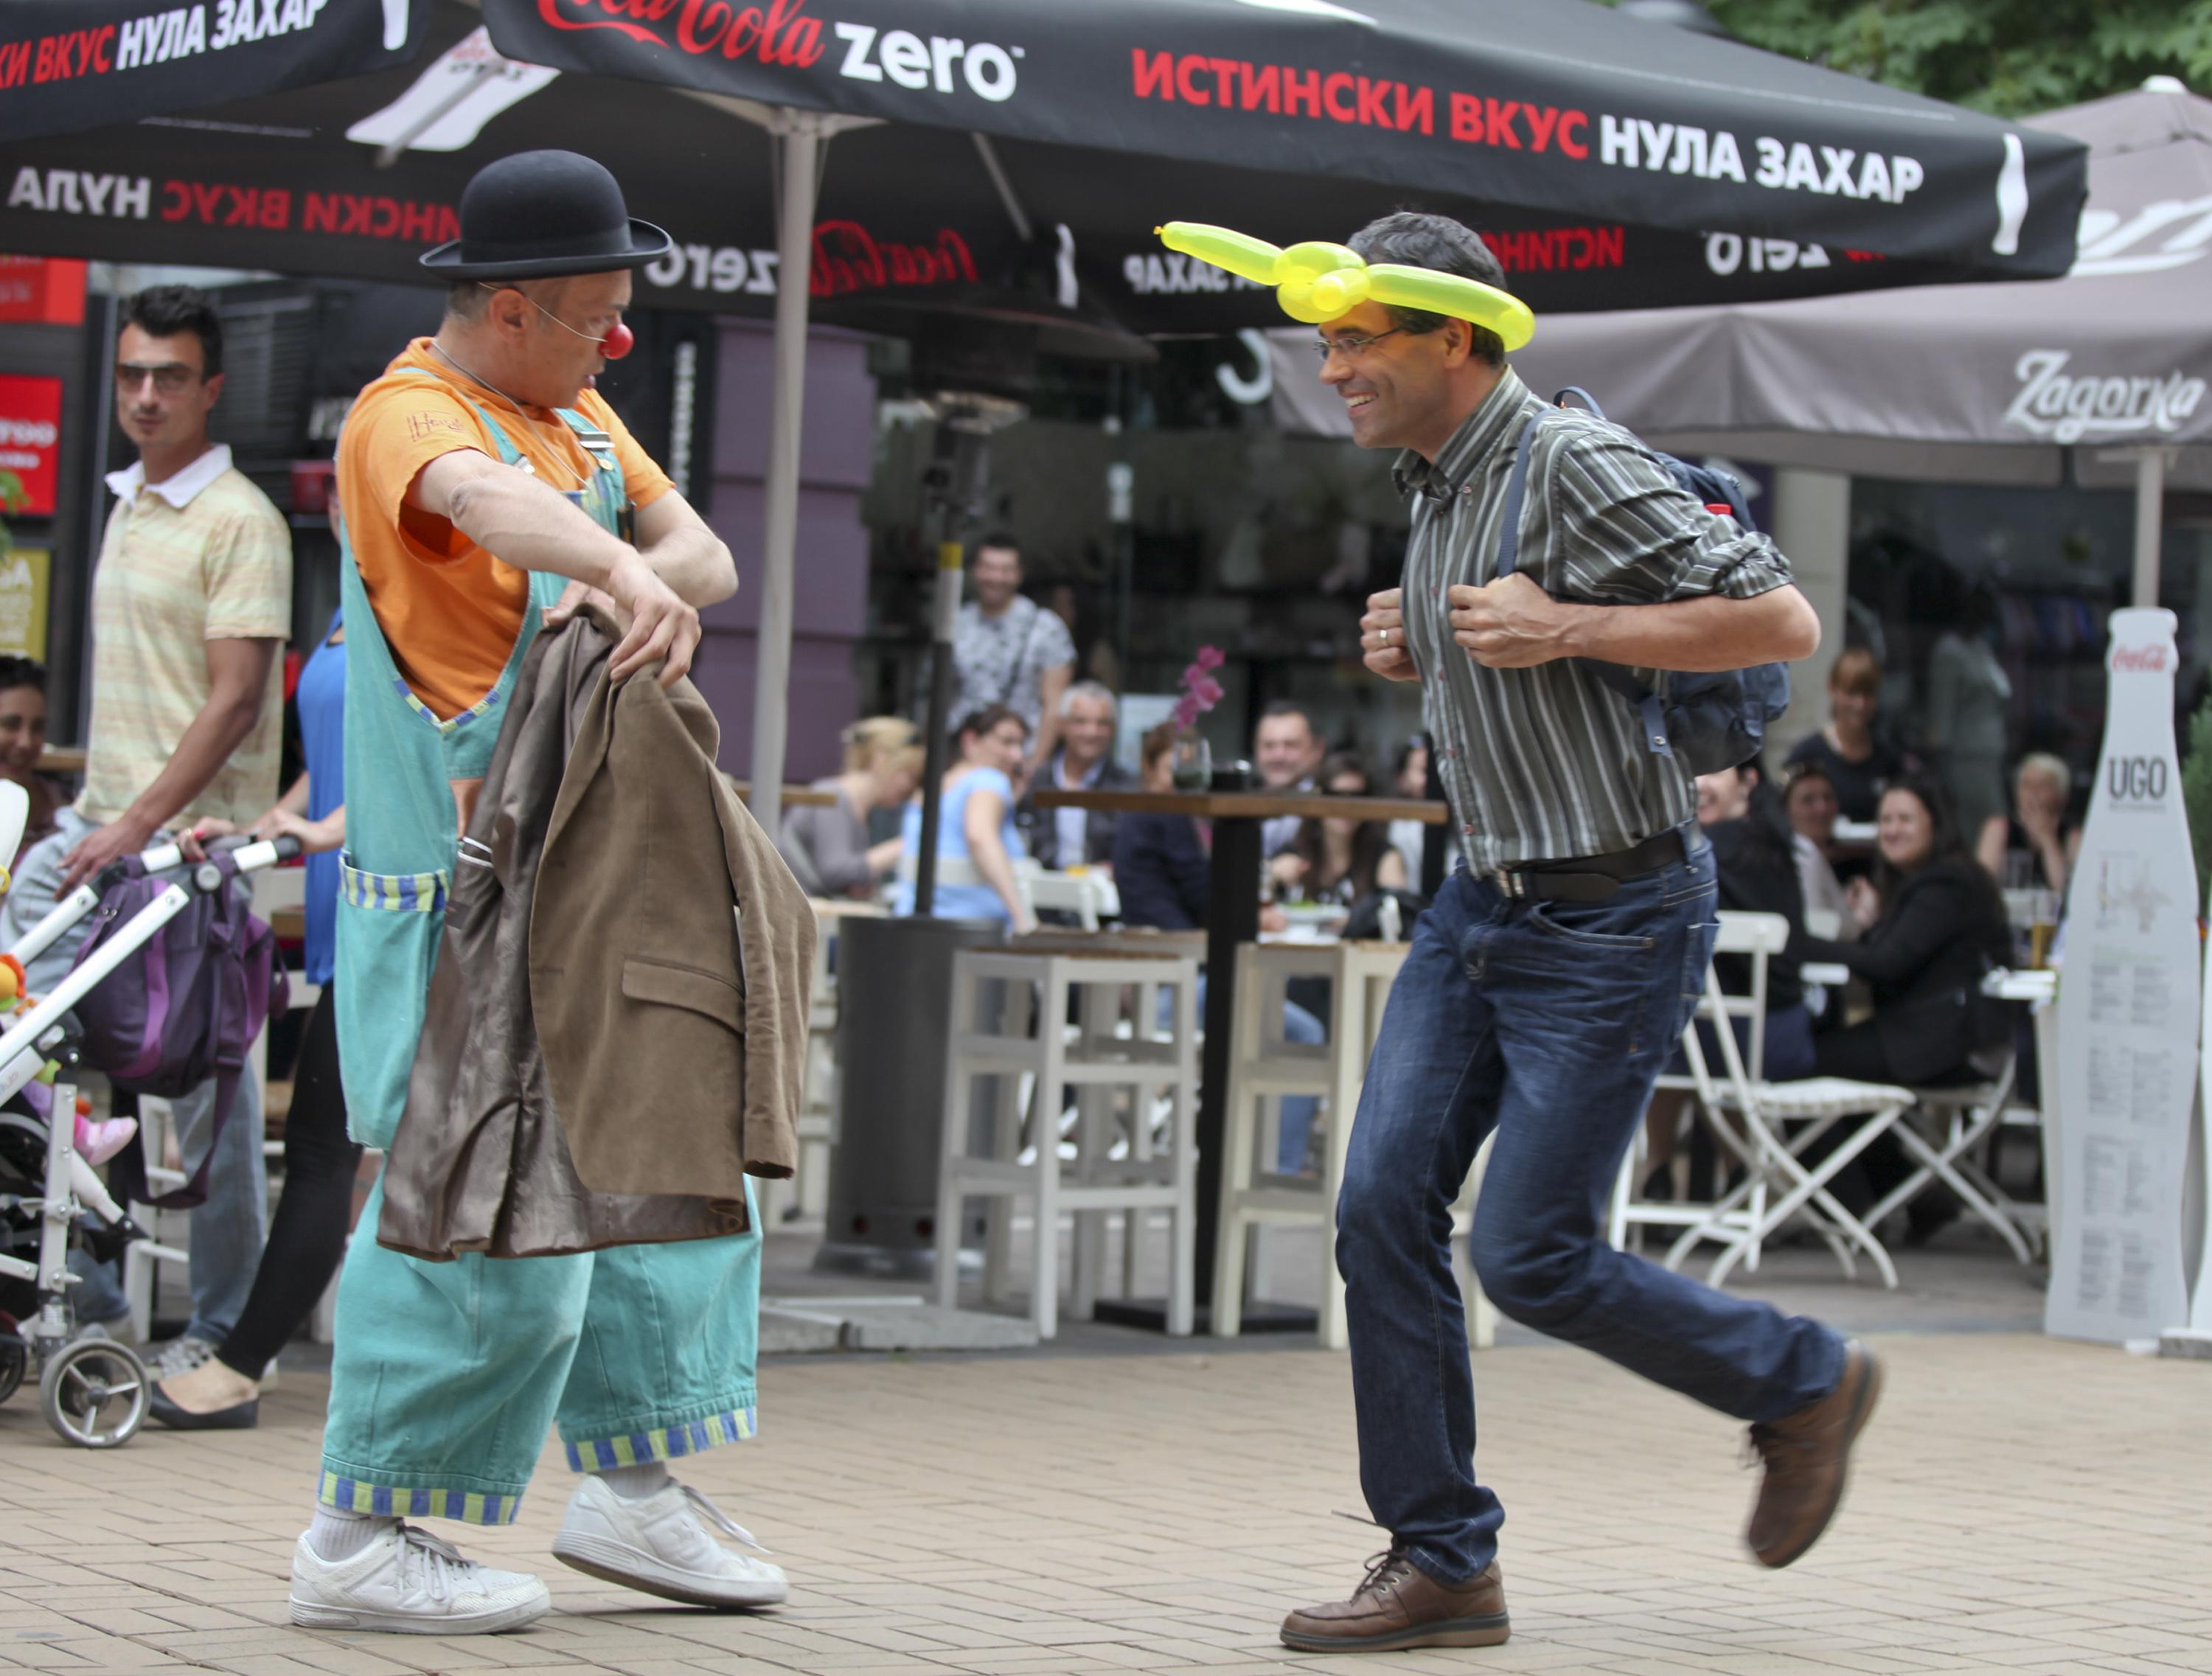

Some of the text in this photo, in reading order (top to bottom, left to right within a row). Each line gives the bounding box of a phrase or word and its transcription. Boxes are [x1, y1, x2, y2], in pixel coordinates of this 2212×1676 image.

[33, 24, 115, 83] ВКУС
[116, 4, 206, 70] НУЛА
[210, 0, 329, 49] ЗАХАР
[1131, 48, 1924, 204] ИСТИНСКИ ВКУС НУЛА ЗАХАР
[2004, 349, 2207, 444] Zagorka
[2110, 756, 2168, 801] UGO
